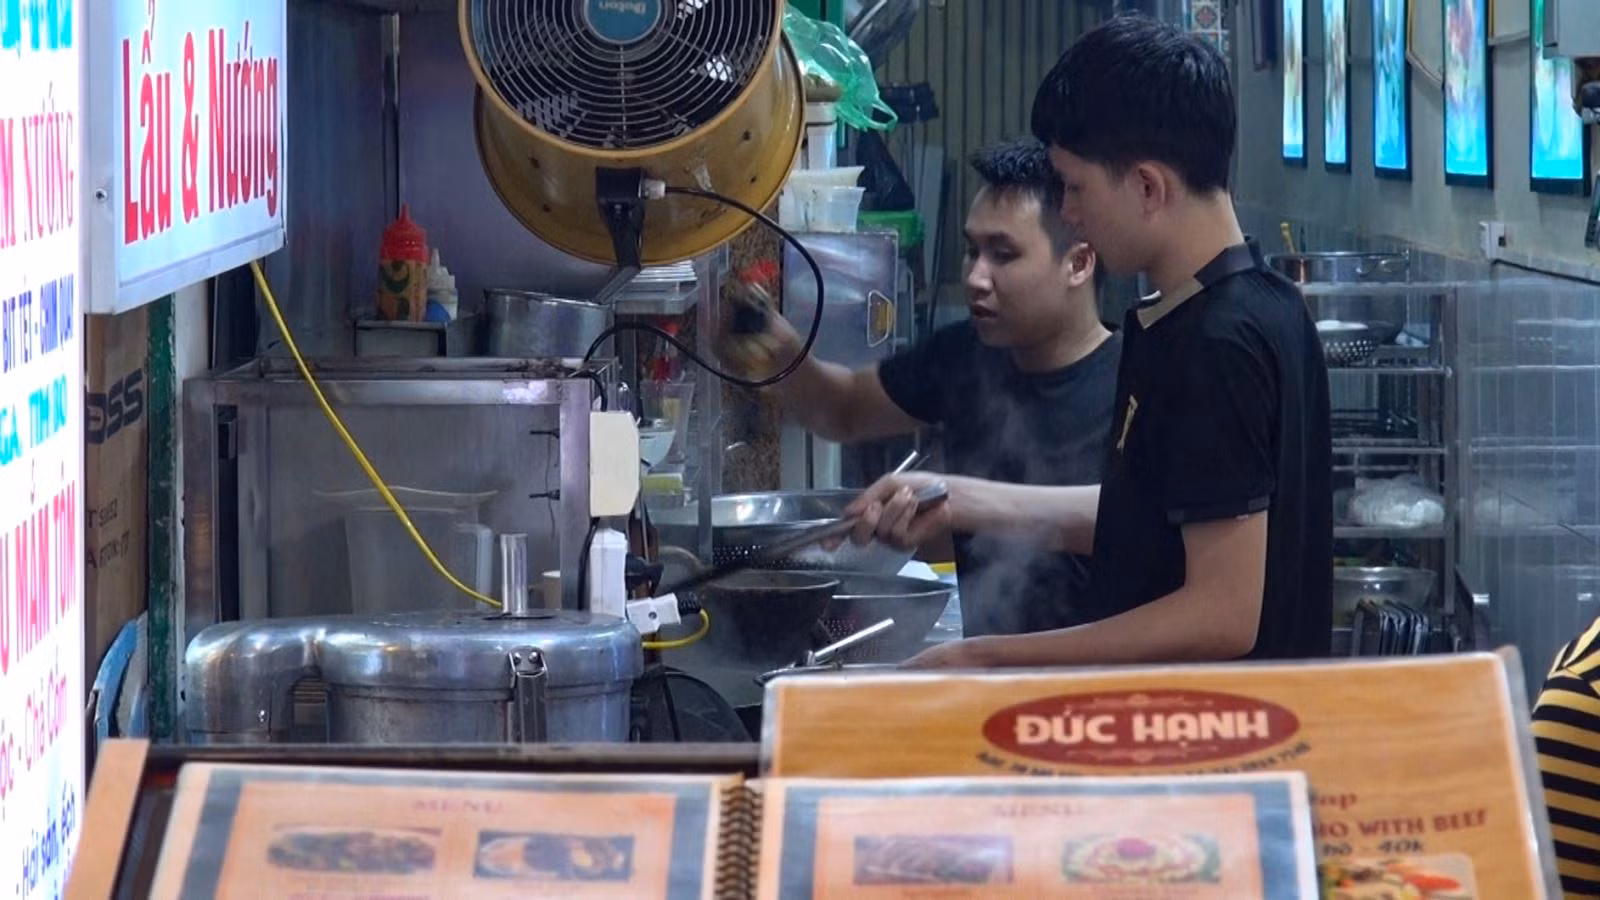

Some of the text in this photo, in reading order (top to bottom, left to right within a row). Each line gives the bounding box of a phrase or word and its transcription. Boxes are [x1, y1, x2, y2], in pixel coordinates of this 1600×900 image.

[121, 0, 278, 245] Lẩu & Nướng
[1014, 700, 1270, 748] ĐỨC HẠNH
[1358, 818, 1424, 836] WITH
[1433, 809, 1487, 833] BEEF
